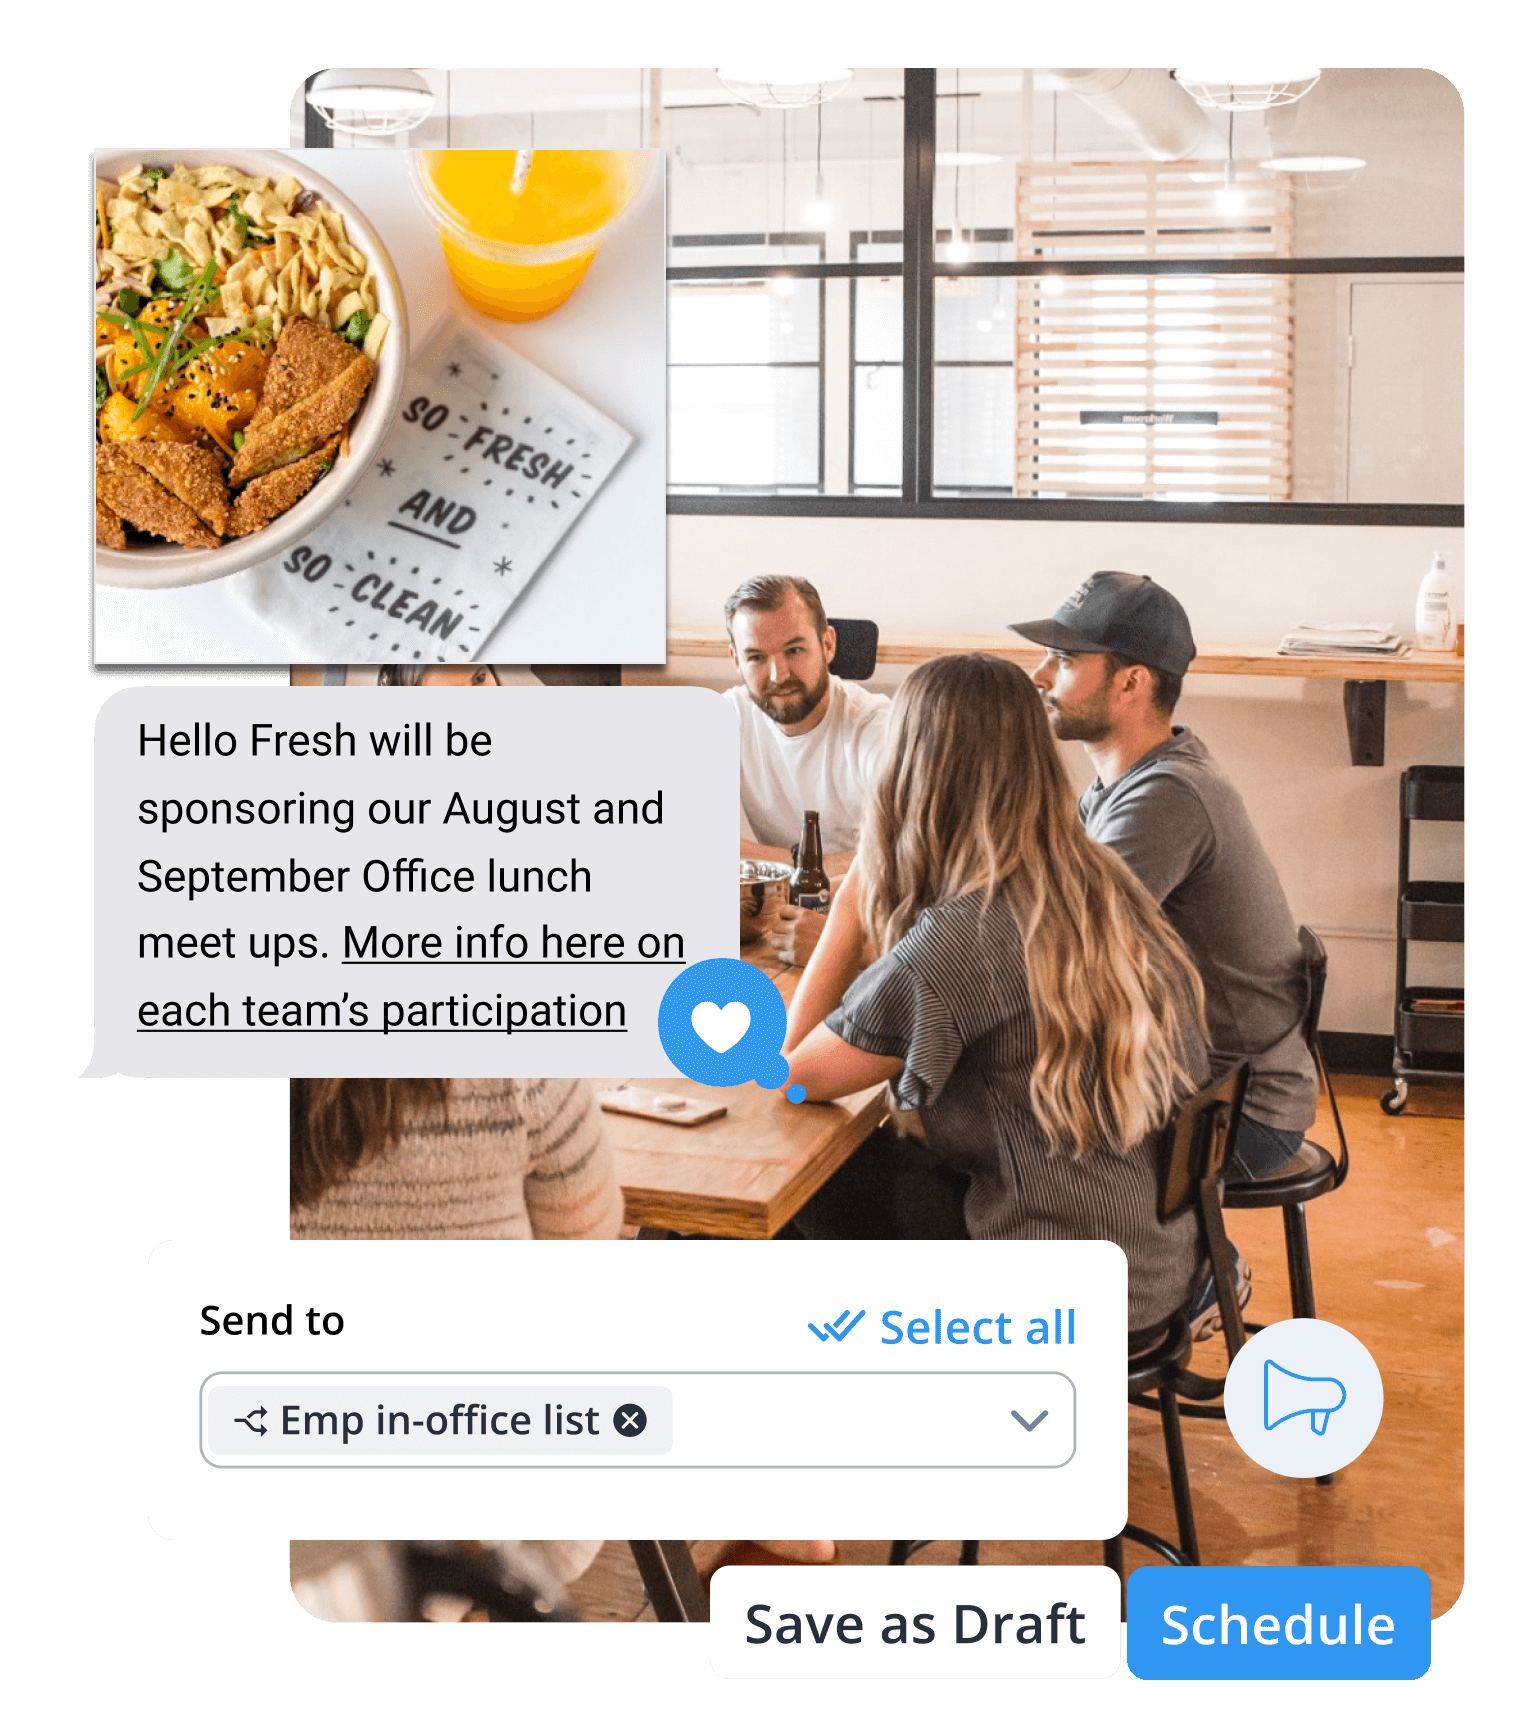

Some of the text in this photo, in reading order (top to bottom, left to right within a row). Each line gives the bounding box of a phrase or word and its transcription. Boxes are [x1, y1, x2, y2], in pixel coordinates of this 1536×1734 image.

[402, 396, 575, 490] SO FRESH
[398, 488, 477, 535] AND
[283, 545, 465, 641] SO CLEAN
